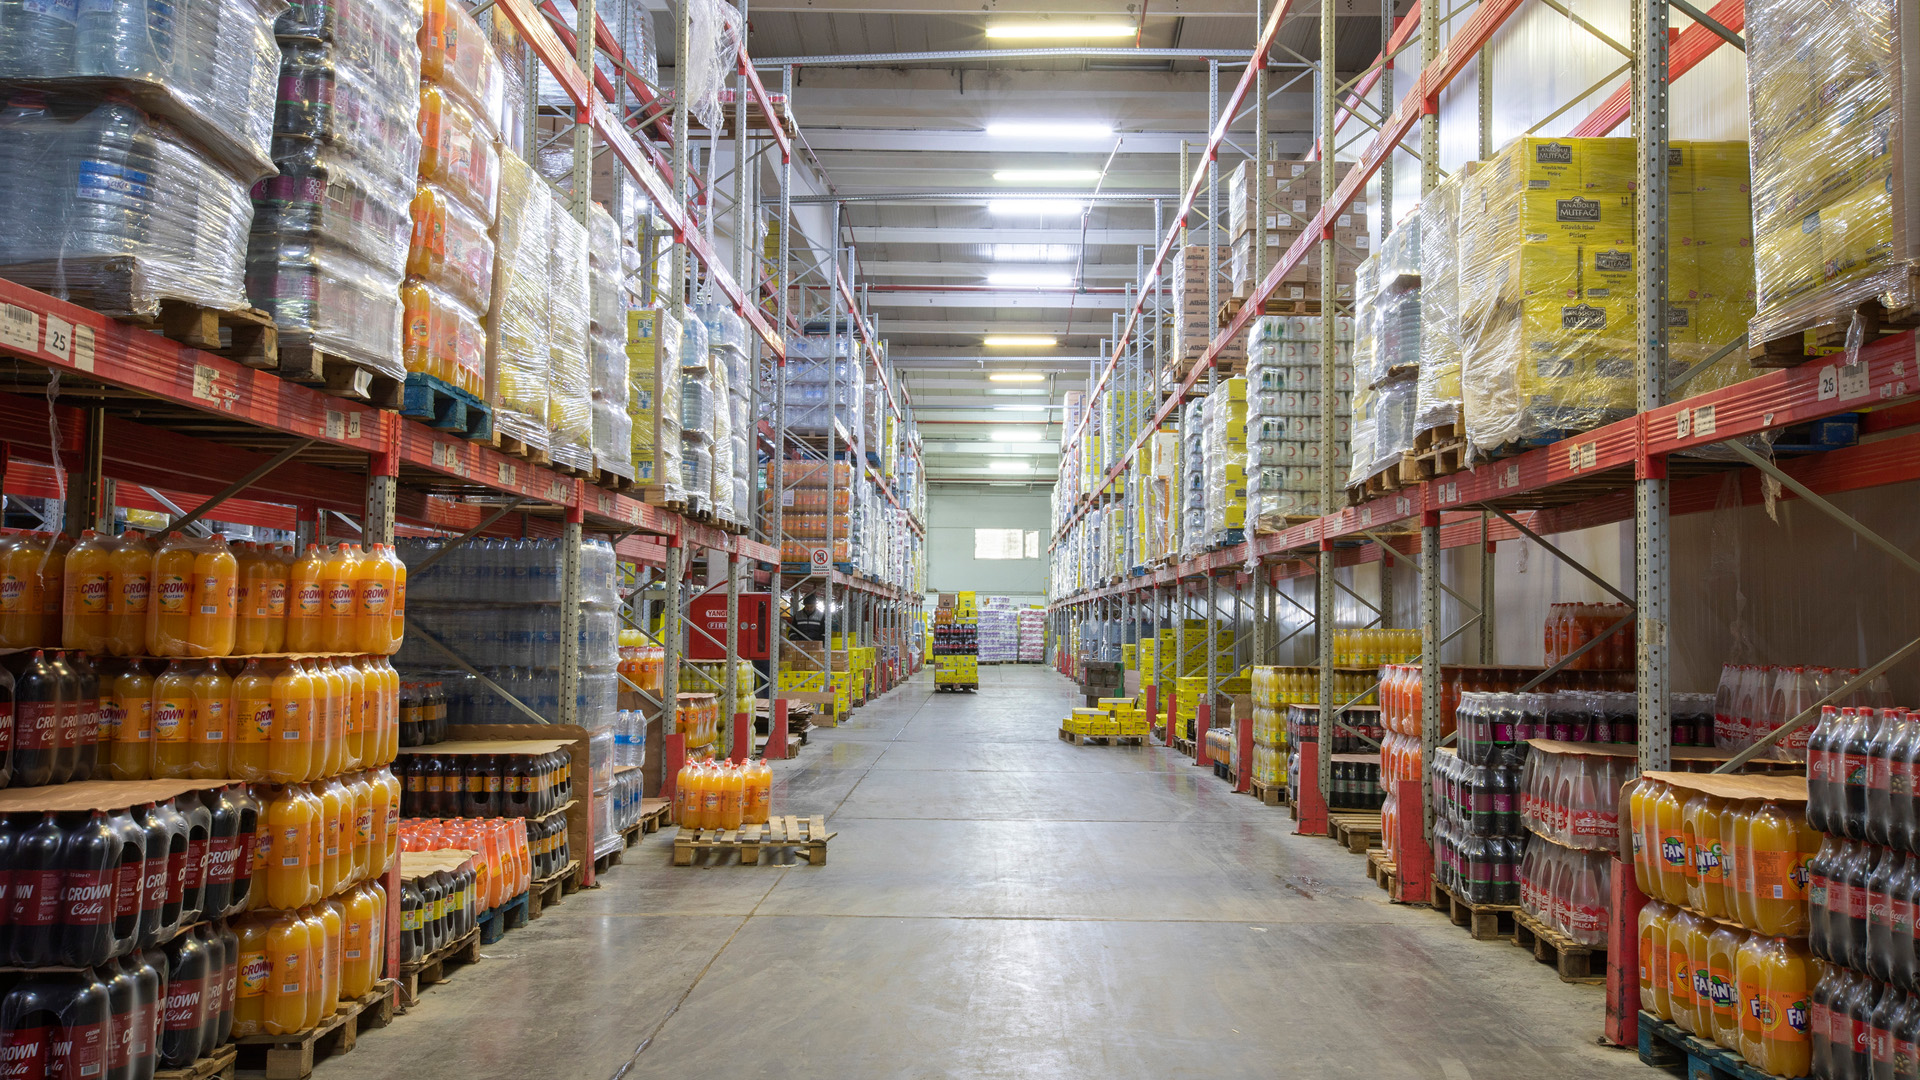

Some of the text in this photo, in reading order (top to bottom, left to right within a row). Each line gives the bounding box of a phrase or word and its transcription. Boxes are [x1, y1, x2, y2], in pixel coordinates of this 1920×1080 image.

[52, 330, 67, 352] 25
[350, 421, 359, 434] 27
[1681, 419, 1689, 432] 27
[80, 583, 107, 594] CROW
[123, 583, 149, 594] CROW
[157, 582, 190, 593] CROWN
[328, 588, 356, 599] CROWN
[362, 588, 390, 599] CROWN
[154, 708, 185, 721] CROWN
[36, 715, 57, 730] CRO
[1661, 842, 1685, 858] FAN
[209, 864, 235, 876] Cola
[146, 871, 168, 889] CRO
[67, 882, 113, 901] CROWN
[70, 902, 104, 916] Cola
[165, 991, 201, 1009] ROWN
[165, 1010, 194, 1023] Cola
